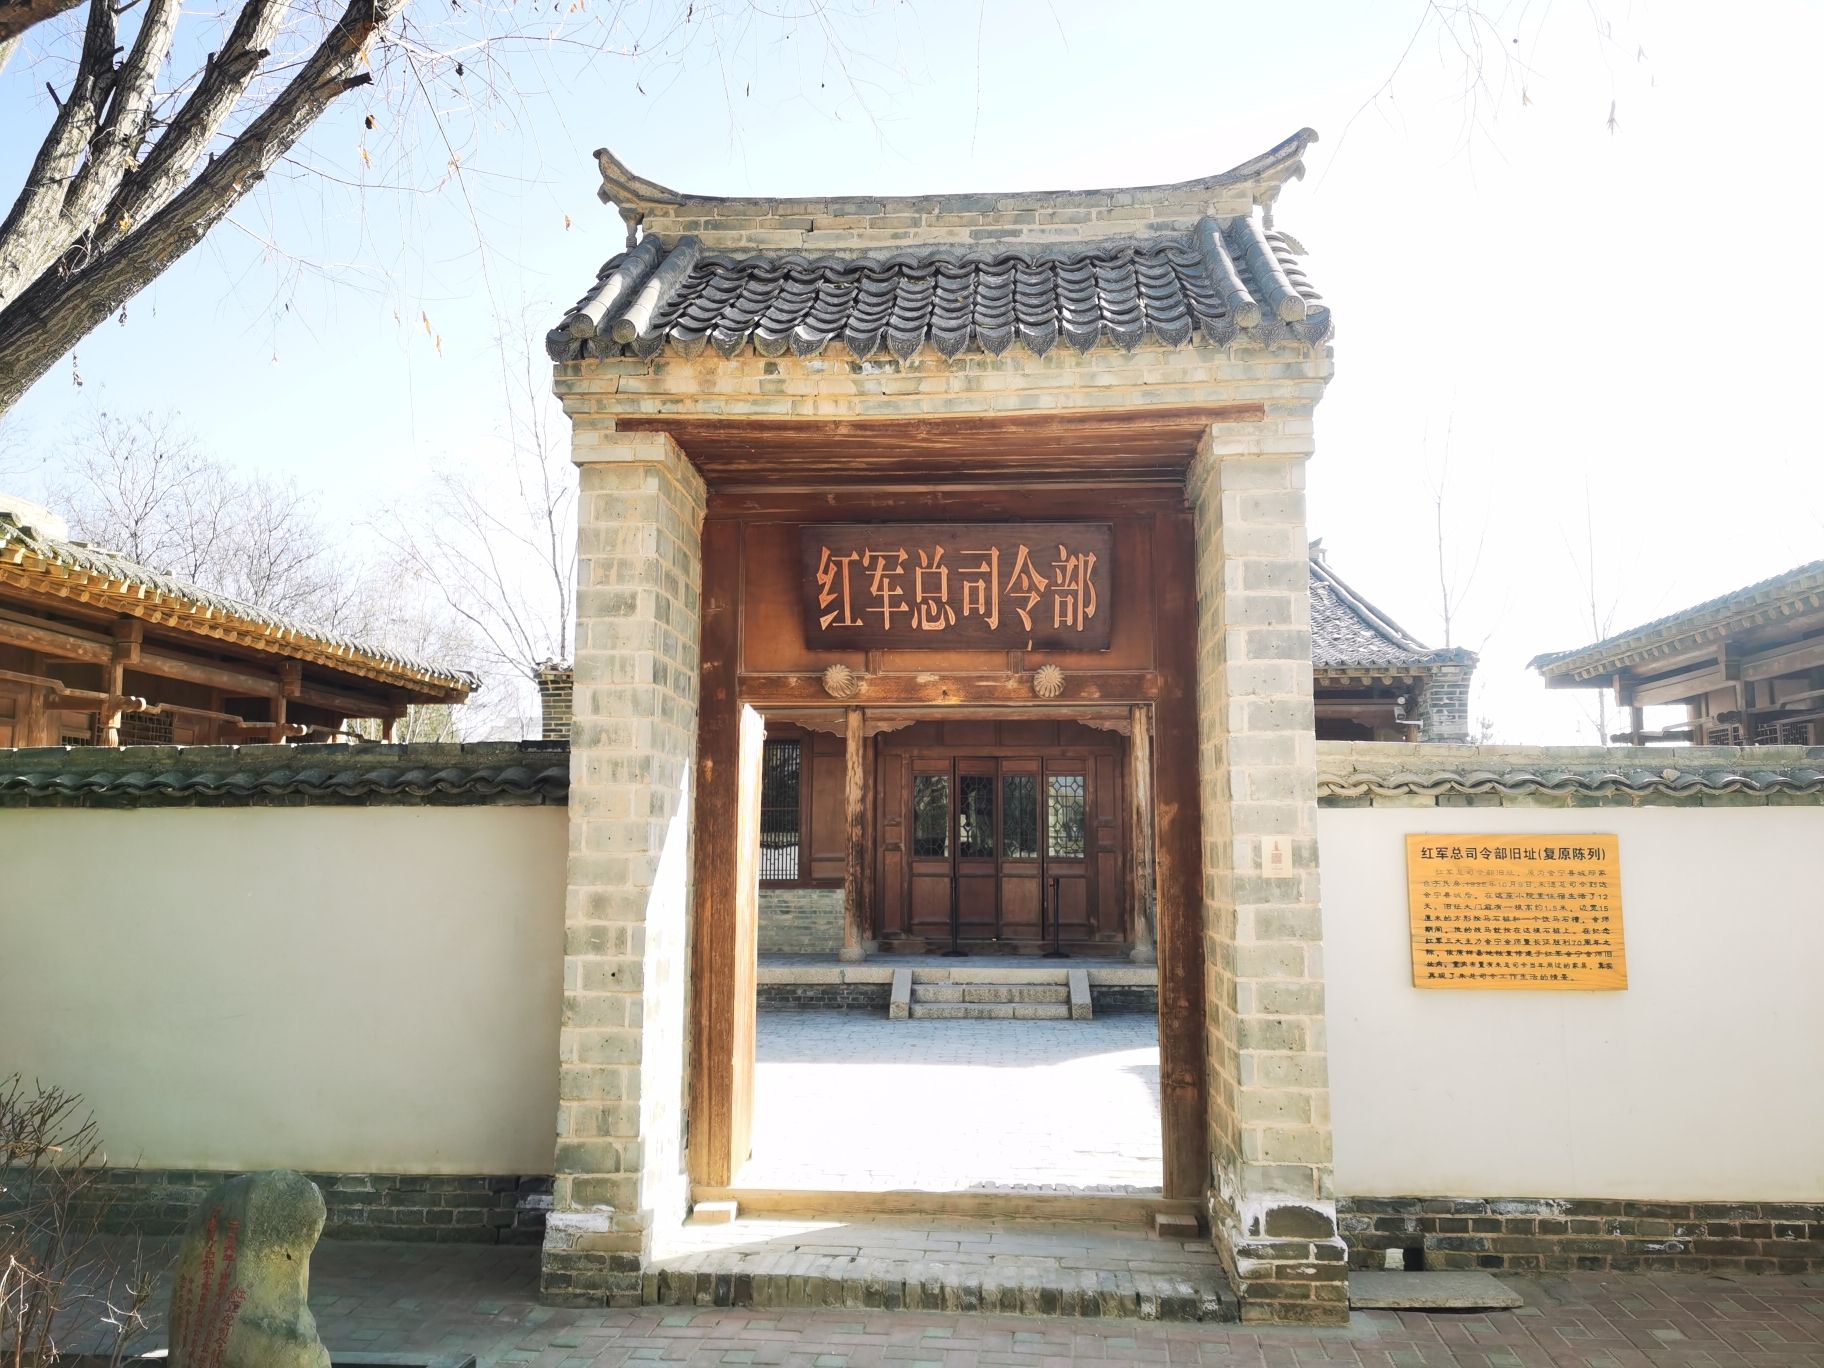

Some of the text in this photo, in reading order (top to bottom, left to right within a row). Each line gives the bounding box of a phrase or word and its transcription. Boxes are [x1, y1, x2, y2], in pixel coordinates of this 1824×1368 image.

[816, 544, 1097, 631] 红军总司令部
